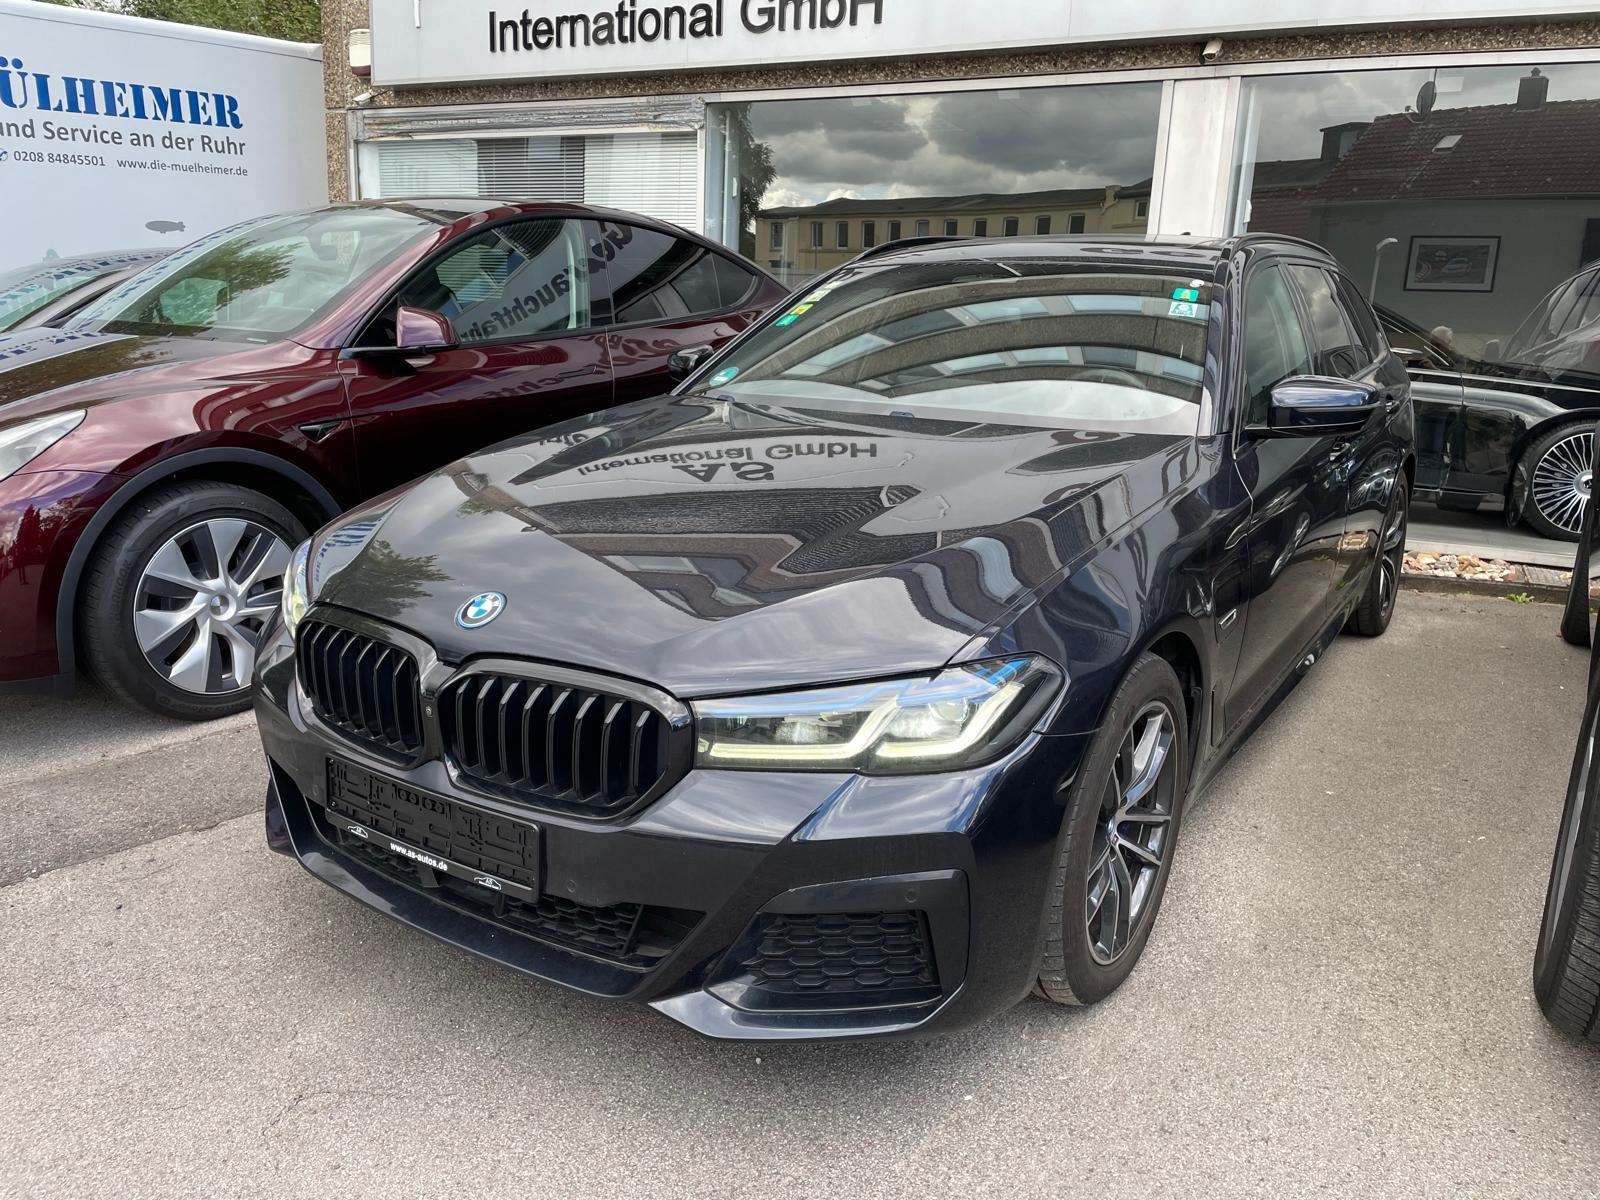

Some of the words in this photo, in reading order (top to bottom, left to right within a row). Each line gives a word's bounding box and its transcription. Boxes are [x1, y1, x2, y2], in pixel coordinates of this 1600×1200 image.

[488, 0, 723, 53] International
[740, 0, 883, 34] GmbH
[0, 56, 243, 129] ÜLHEIMER
[42, 121, 123, 145] Service
[130, 132, 155, 148] an
[161, 131, 195, 151] der
[200, 134, 246, 156] Ruhr
[13, 150, 44, 163] 0208
[47, 152, 106, 167] 84845501
[116, 159, 248, 176] www.die-muelheimer.de
[390, 842, 448, 872] www.as-autos.de
